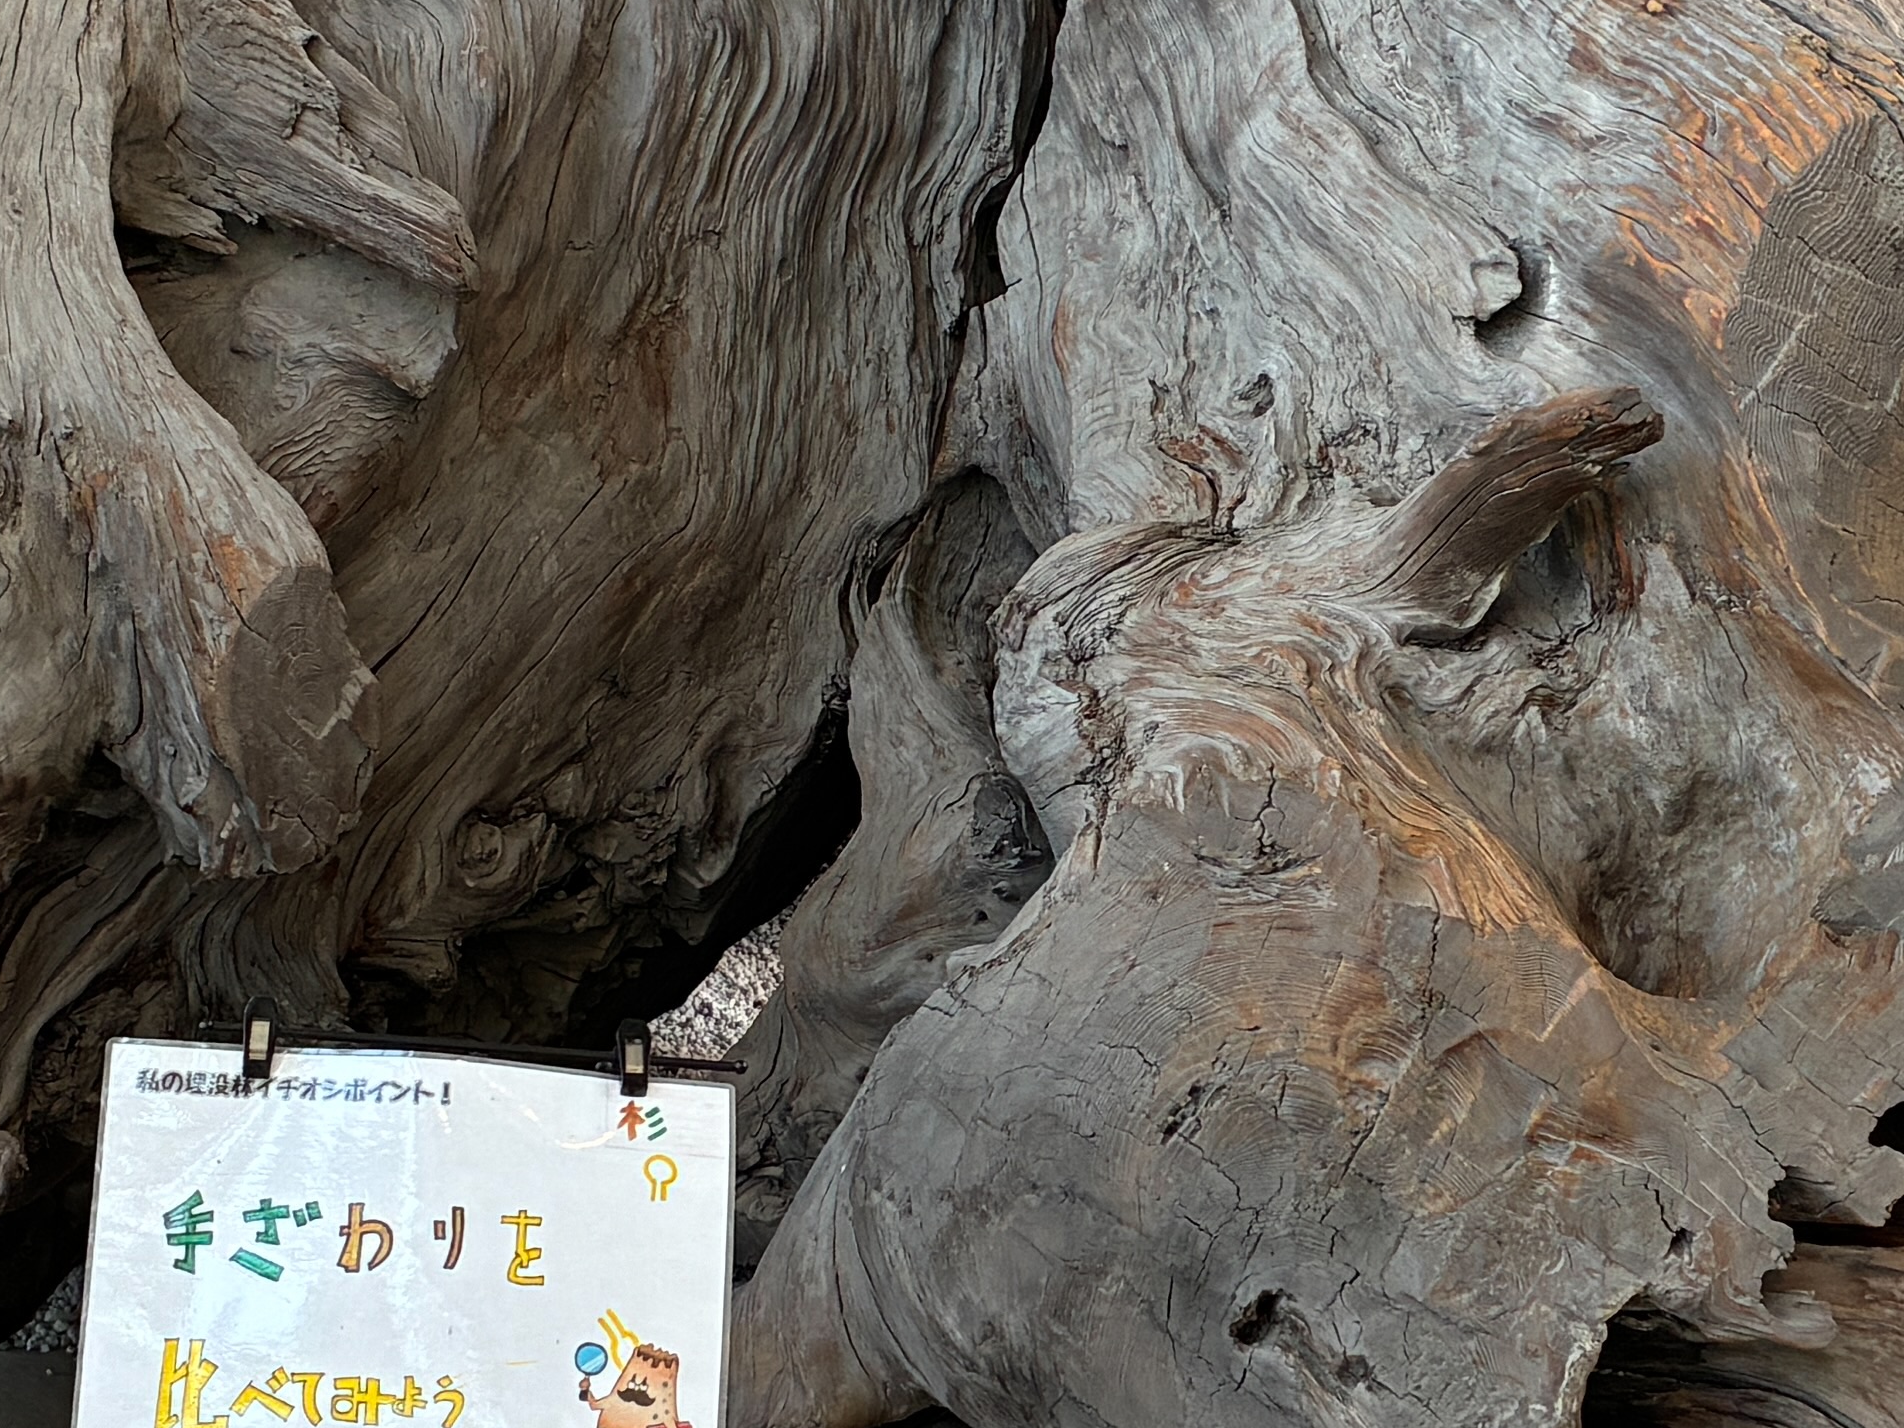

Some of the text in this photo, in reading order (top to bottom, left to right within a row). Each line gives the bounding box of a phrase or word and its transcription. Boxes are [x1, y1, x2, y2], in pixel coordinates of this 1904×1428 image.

[162, 1190, 545, 1286] 手ざわりを
